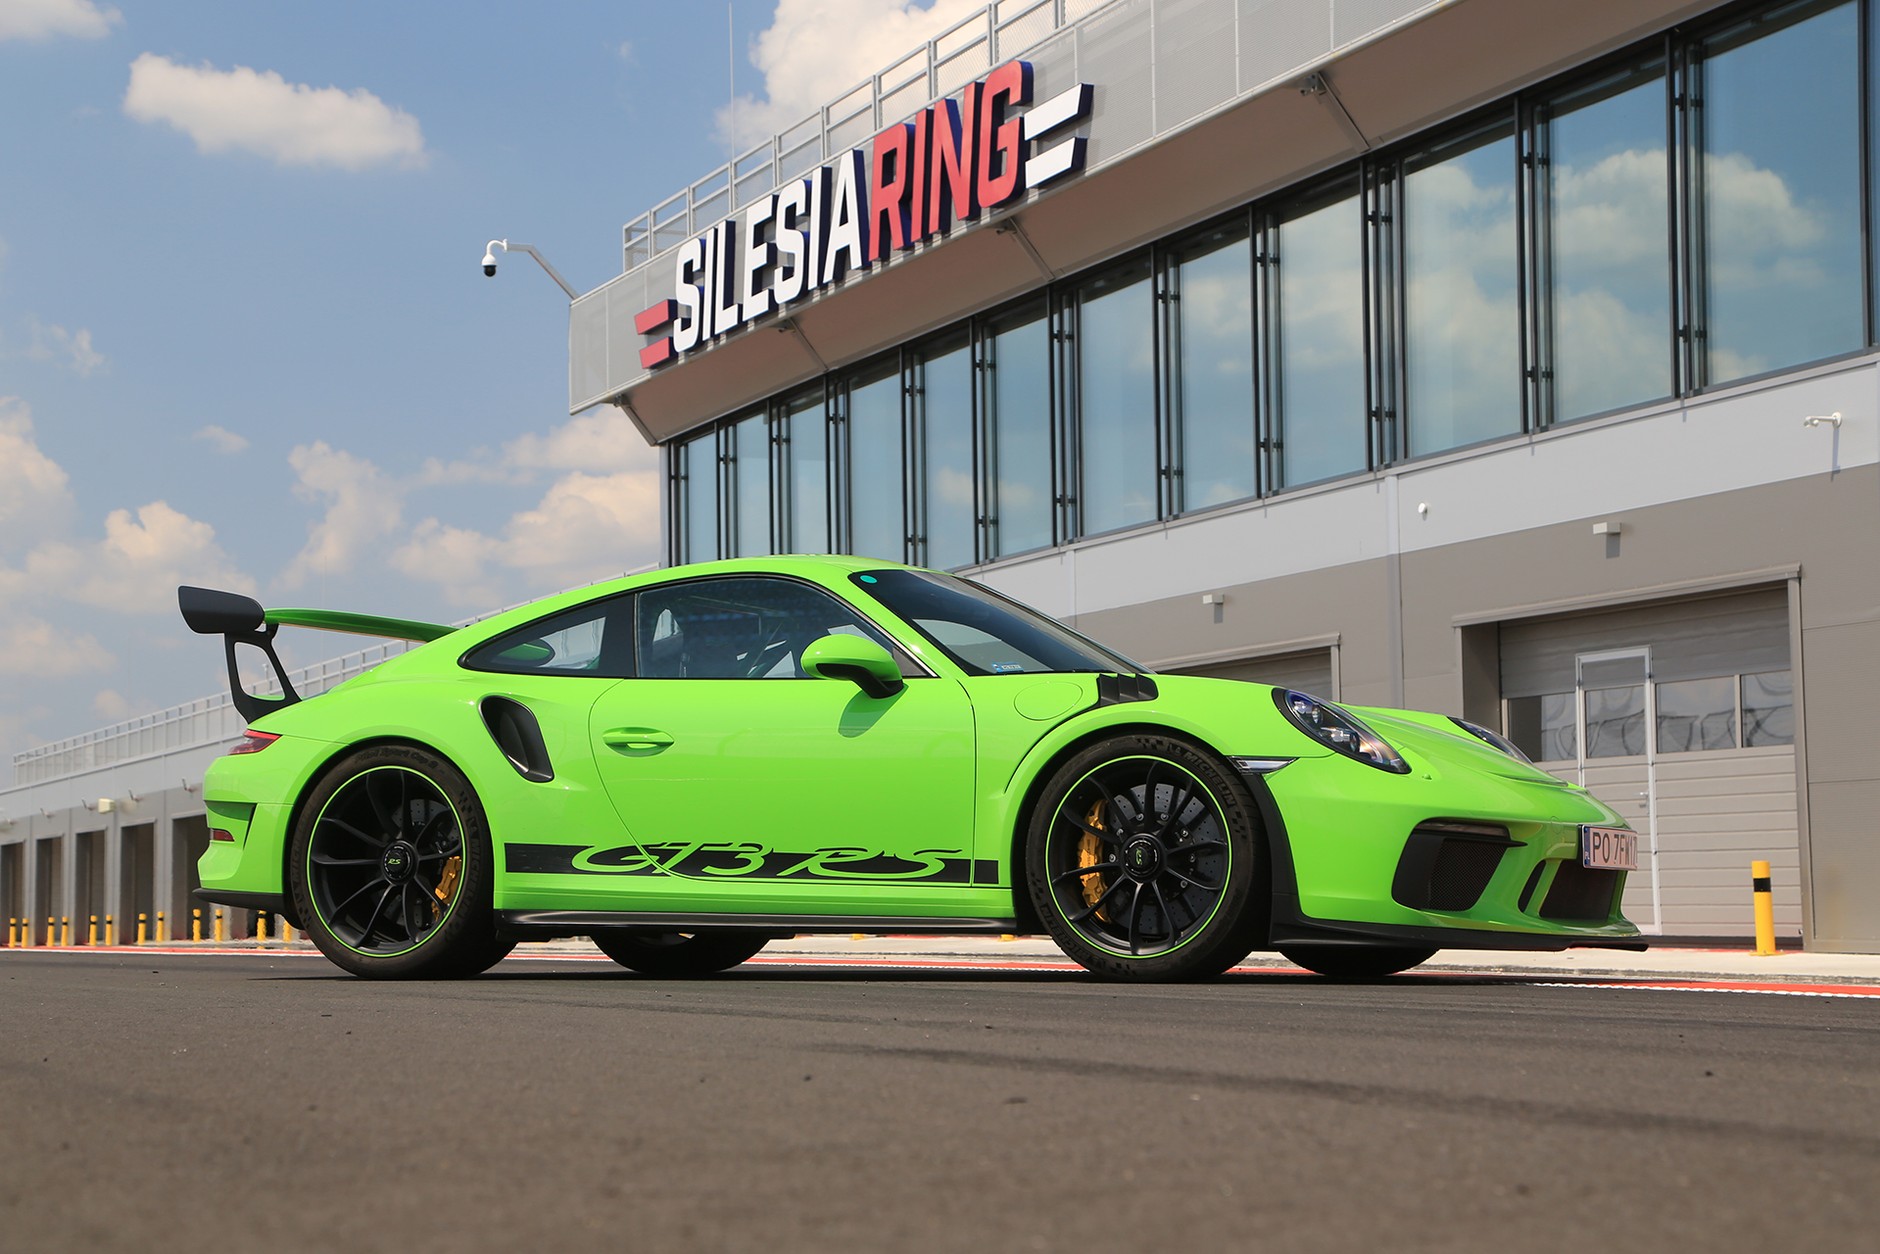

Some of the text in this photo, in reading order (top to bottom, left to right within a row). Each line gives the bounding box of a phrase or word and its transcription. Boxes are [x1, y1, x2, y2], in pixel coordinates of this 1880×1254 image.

[1183, 750, 1237, 808] MICHELIN
[571, 842, 963, 880] GT3 RS
[1592, 832, 1610, 864] PO
[1039, 903, 1091, 962] MICHELIN
